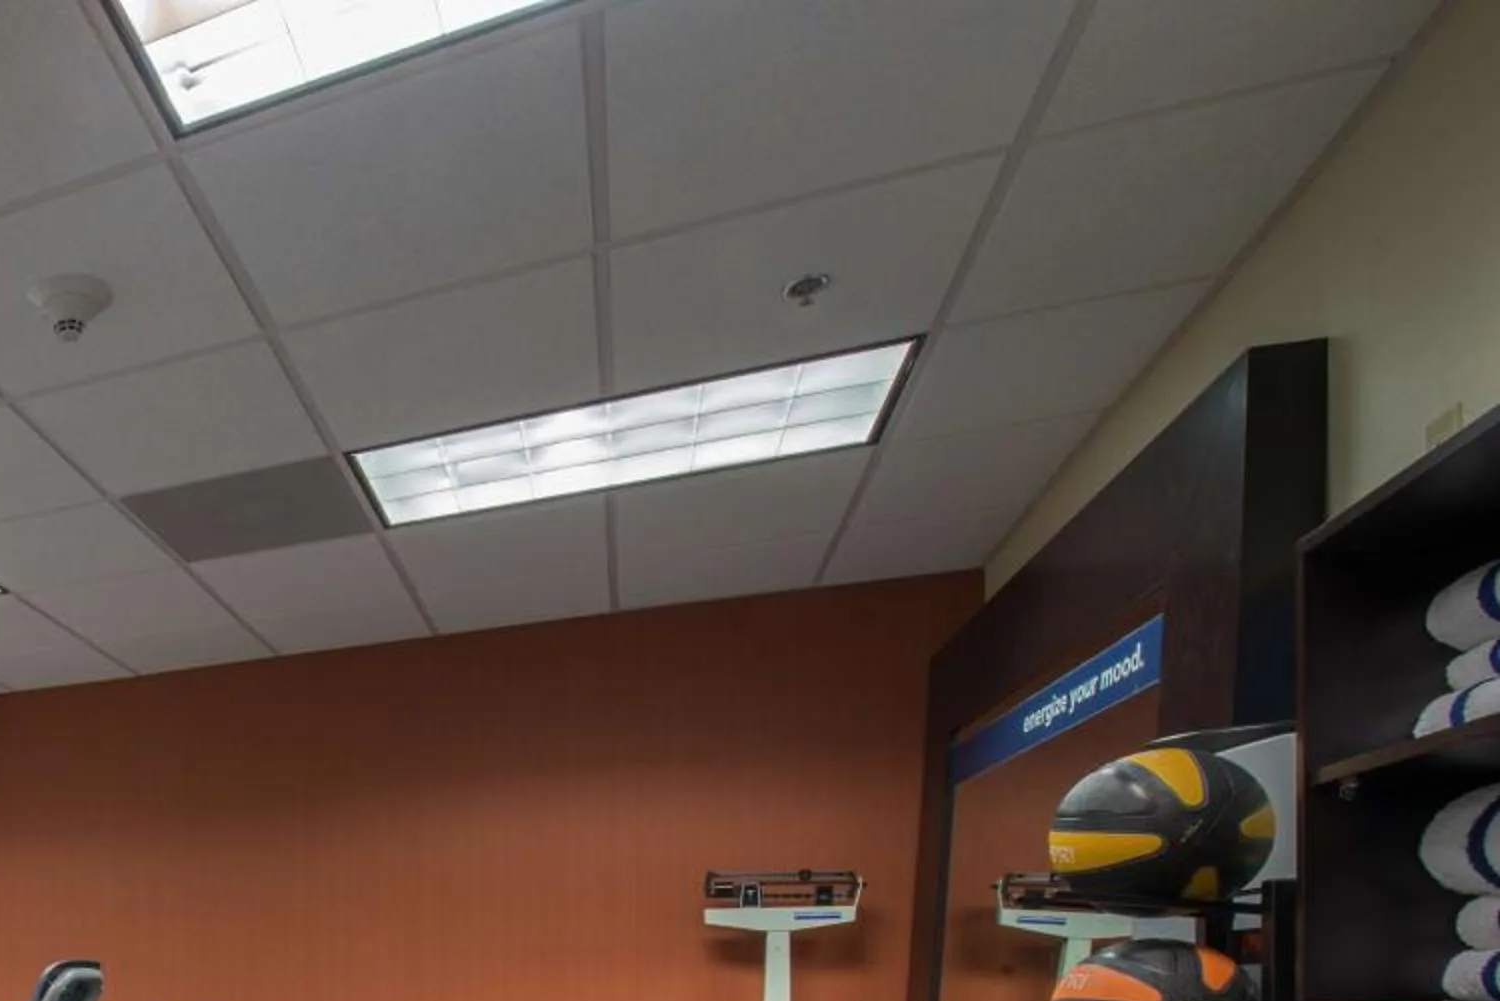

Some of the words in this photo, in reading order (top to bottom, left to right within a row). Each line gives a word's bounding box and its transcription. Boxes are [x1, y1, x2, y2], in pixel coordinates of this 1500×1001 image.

[1023, 693, 1068, 733] energize
[1068, 675, 1099, 714] your
[1099, 642, 1145, 691] mood.
